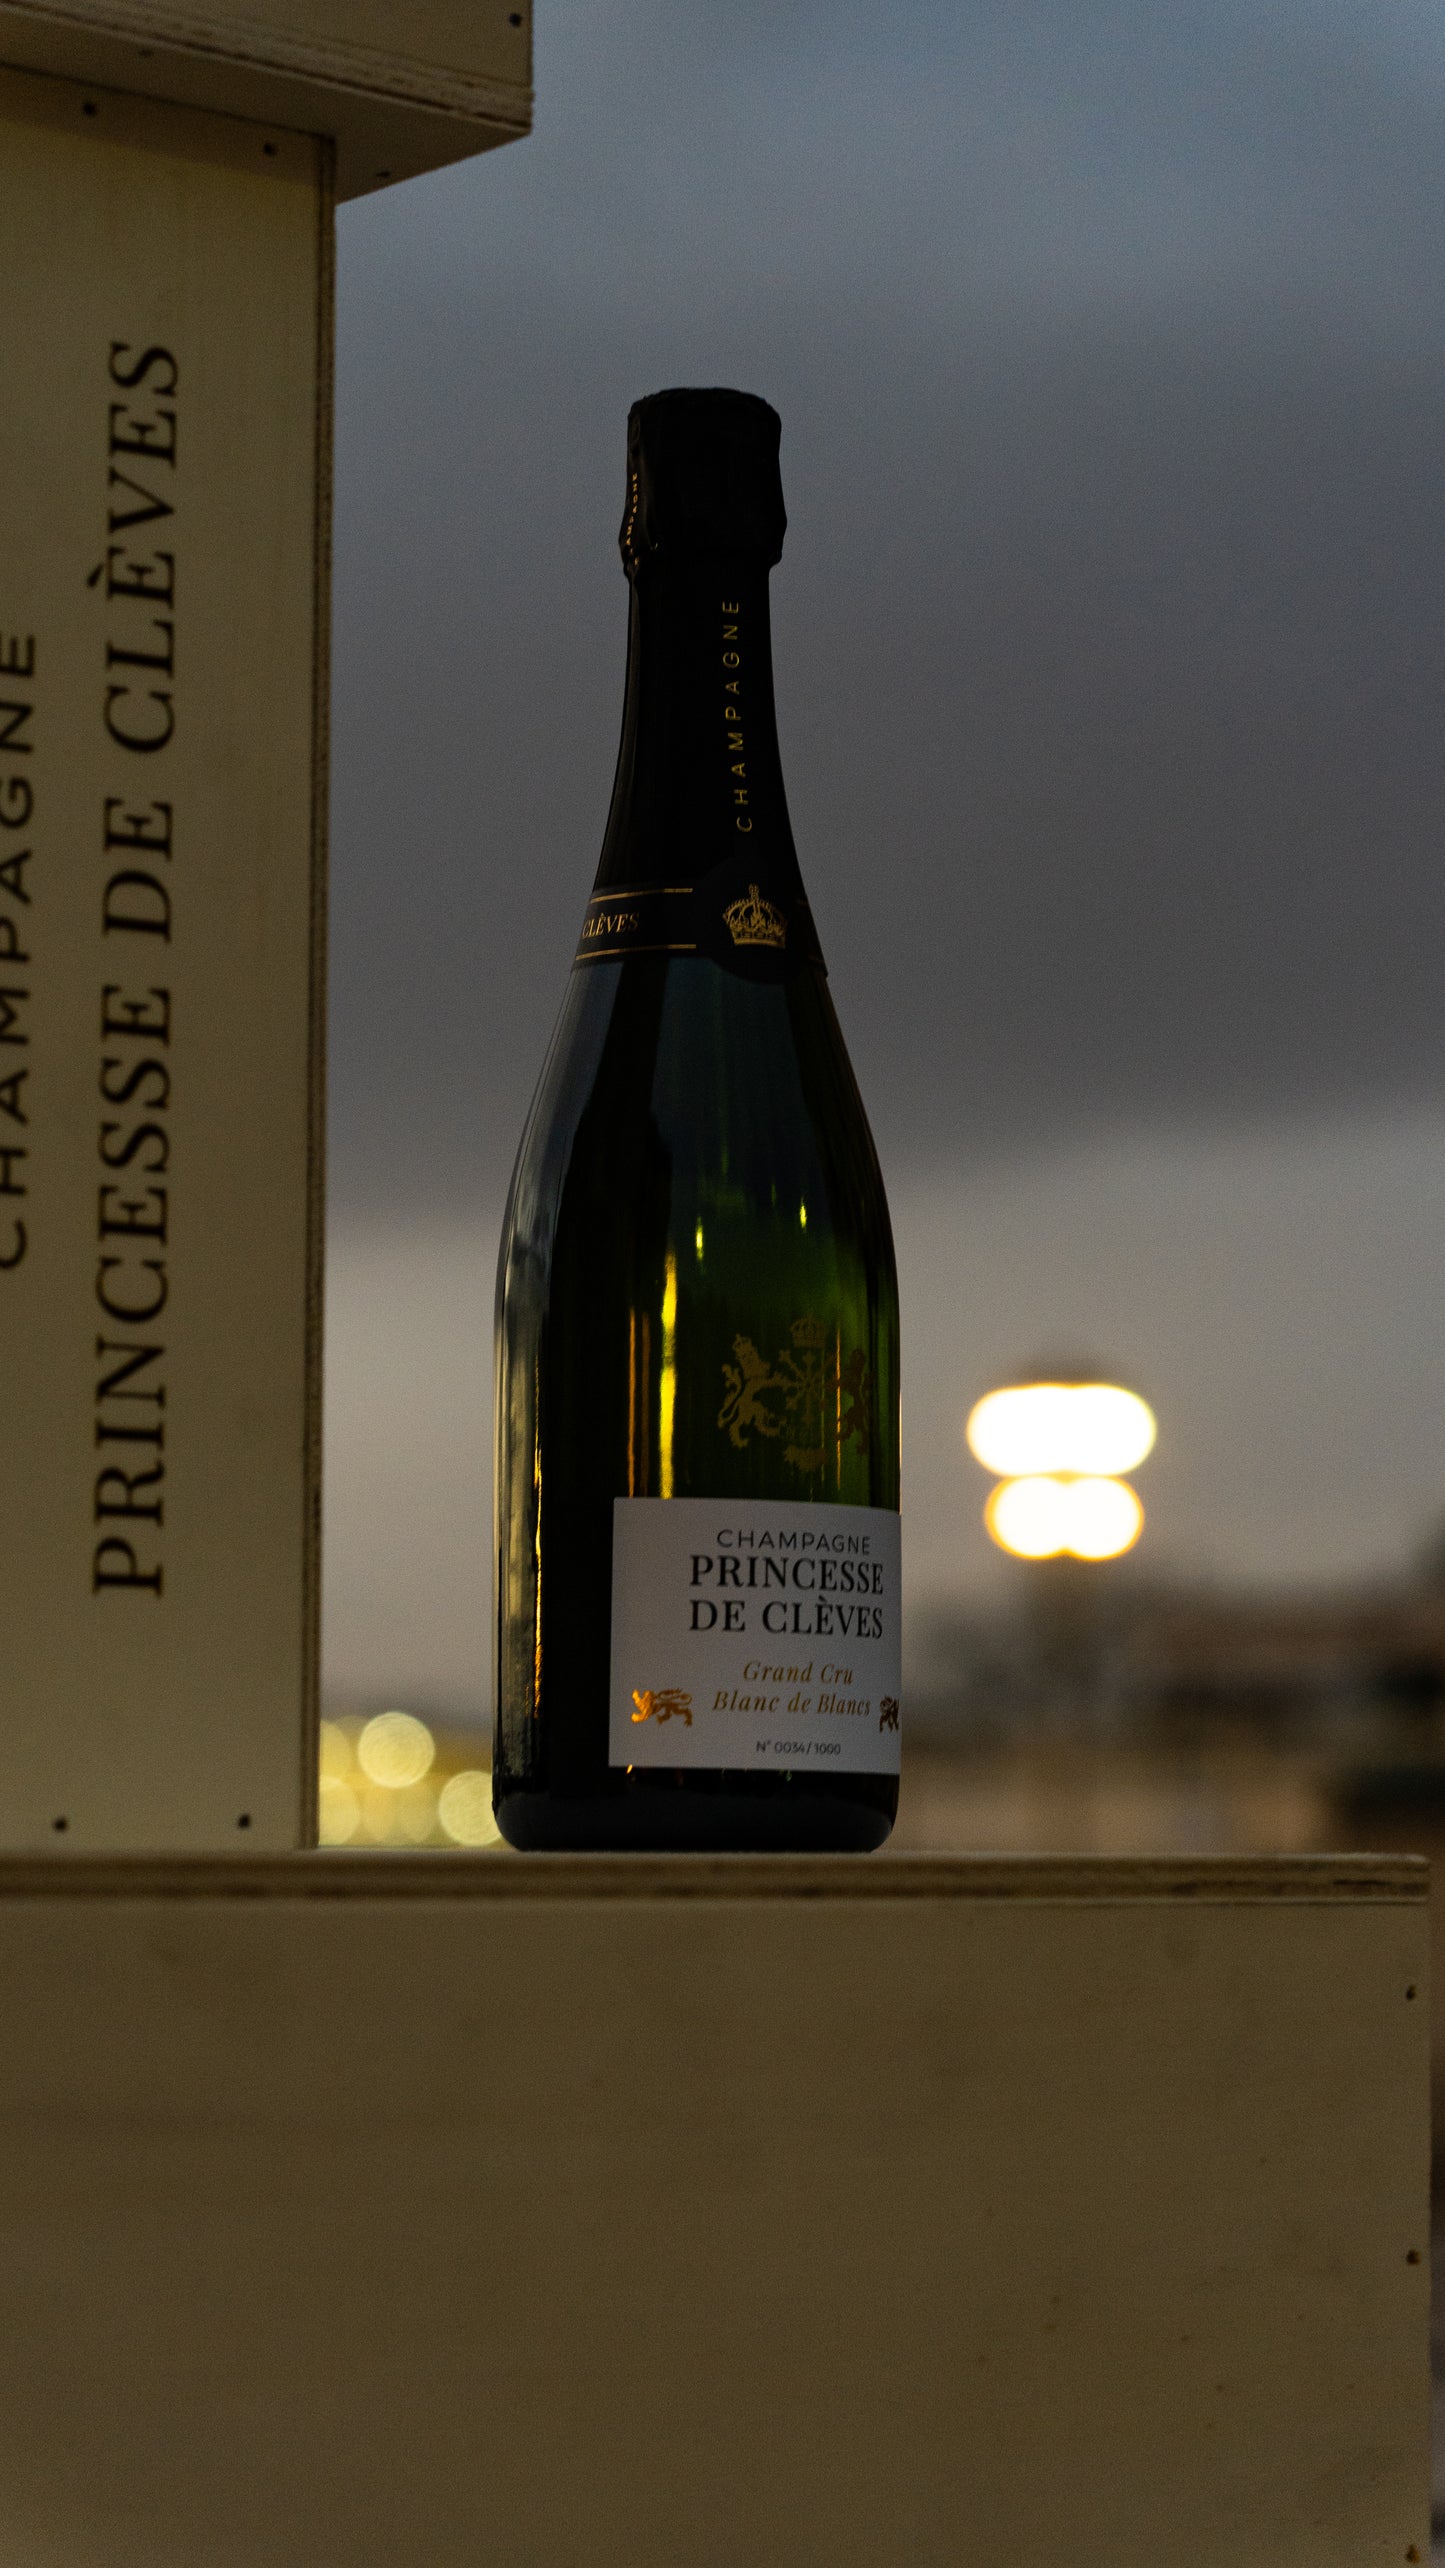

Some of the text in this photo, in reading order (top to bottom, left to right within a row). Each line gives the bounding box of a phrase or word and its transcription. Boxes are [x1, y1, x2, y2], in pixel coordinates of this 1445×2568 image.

[721, 599, 753, 833] CHAMPAGNE
[582, 911, 640, 939] CLÈVES
[0, 635, 35, 1269] CHAMPAGNE
[88, 341, 179, 1597] PRINCESSE DE CLÈVES
[716, 1529, 871, 1556] CHAMPAGNE
[689, 1554, 884, 1596] PRINCESSE
[689, 1596, 883, 1639] DE CLÈVES
[743, 1660, 854, 1685] Grand Cru
[712, 1690, 871, 1717] Blanc de Blancs
